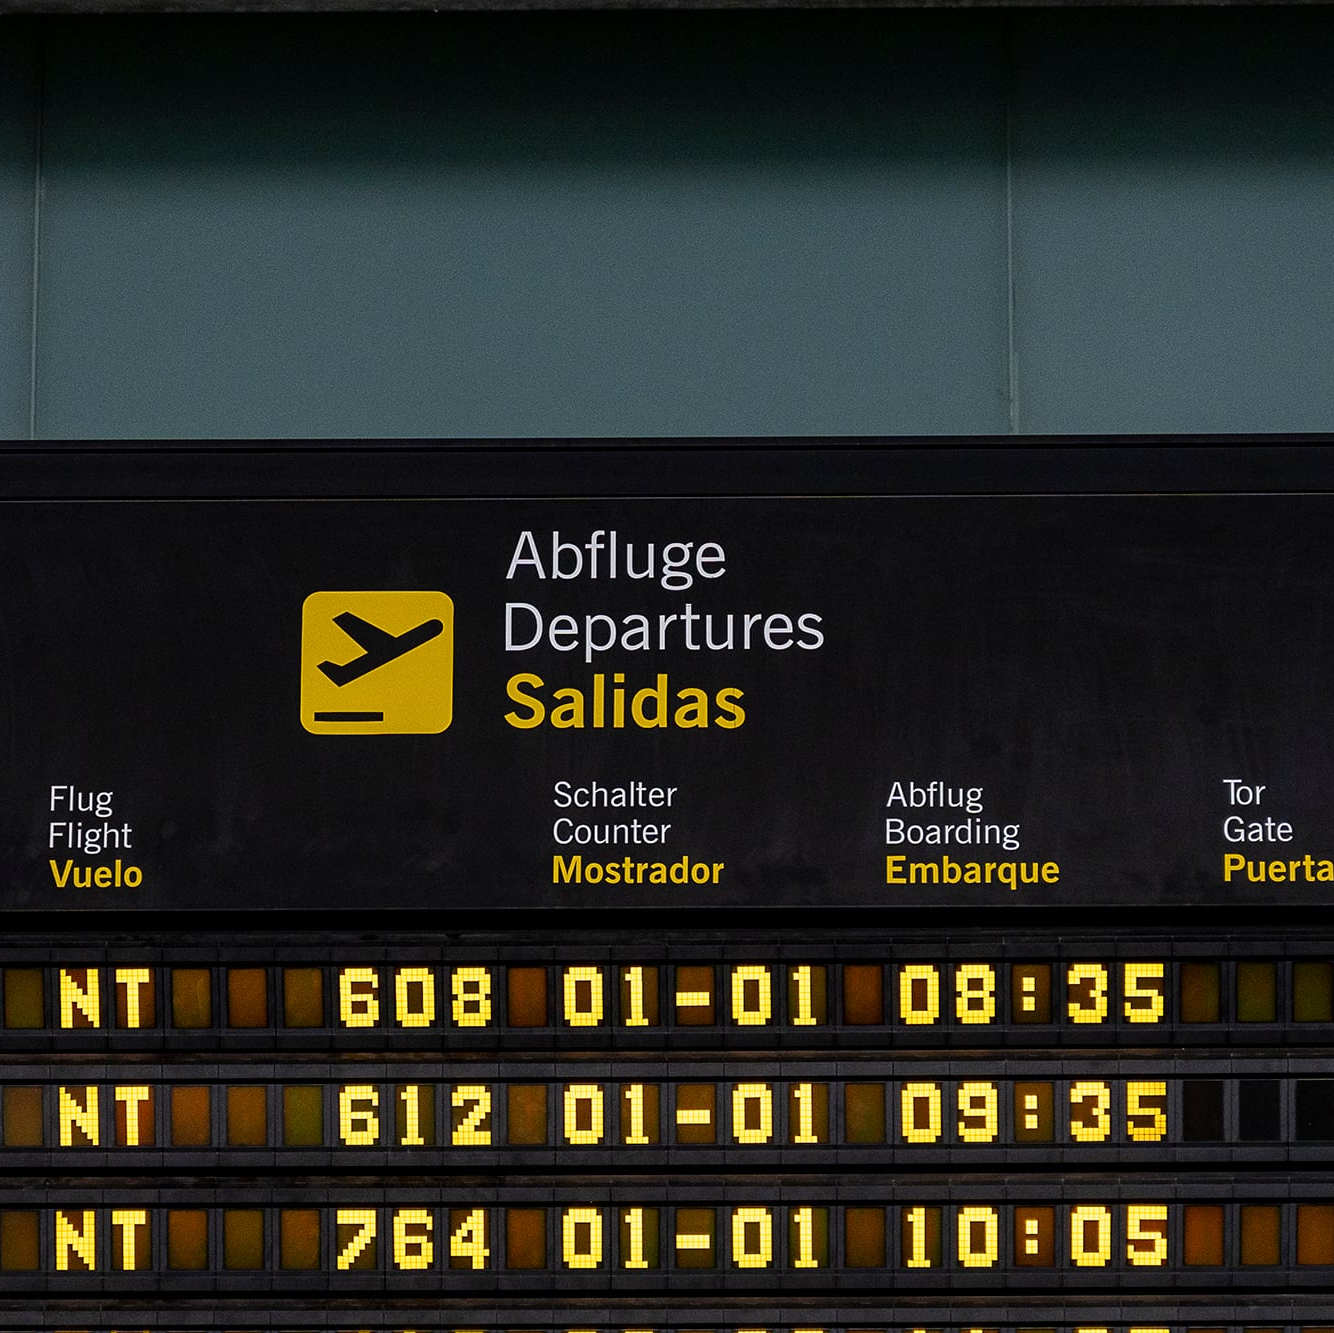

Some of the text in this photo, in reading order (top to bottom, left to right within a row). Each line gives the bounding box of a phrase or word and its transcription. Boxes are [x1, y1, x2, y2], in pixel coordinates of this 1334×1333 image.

[506, 530, 725, 590] Abfluge
[505, 603, 824, 663] Departures
[504, 673, 745, 729] Salidas
[51, 786, 113, 817] Flug
[554, 781, 677, 807] Schalter
[886, 780, 984, 813] Abflug
[1223, 779, 1266, 805] Tor
[50, 822, 132, 854] Flight
[554, 818, 671, 844] Counter
[885, 818, 1021, 850] Boarding
[1224, 816, 1293, 842] Gate
[50, 859, 142, 887] Vuelo
[553, 856, 724, 884] Mostrador
[886, 855, 1060, 891] Embarque
[1224, 854, 1334, 882] Puerta
[59, 968, 150, 1029] NT
[339, 967, 492, 1028] 608
[563, 965, 817, 1027] 01-01
[899, 963, 1164, 1025] 08:35
[59, 1085, 150, 1147] NT
[339, 1085, 492, 1146] 612
[563, 1083, 818, 1145] 01-01
[901, 1081, 1167, 1143] 09:35
[55, 1210, 146, 1271] NT
[336, 1209, 490, 1270] 764
[562, 1207, 818, 1269] 01-01
[907, 1205, 1168, 1268] 10:05
